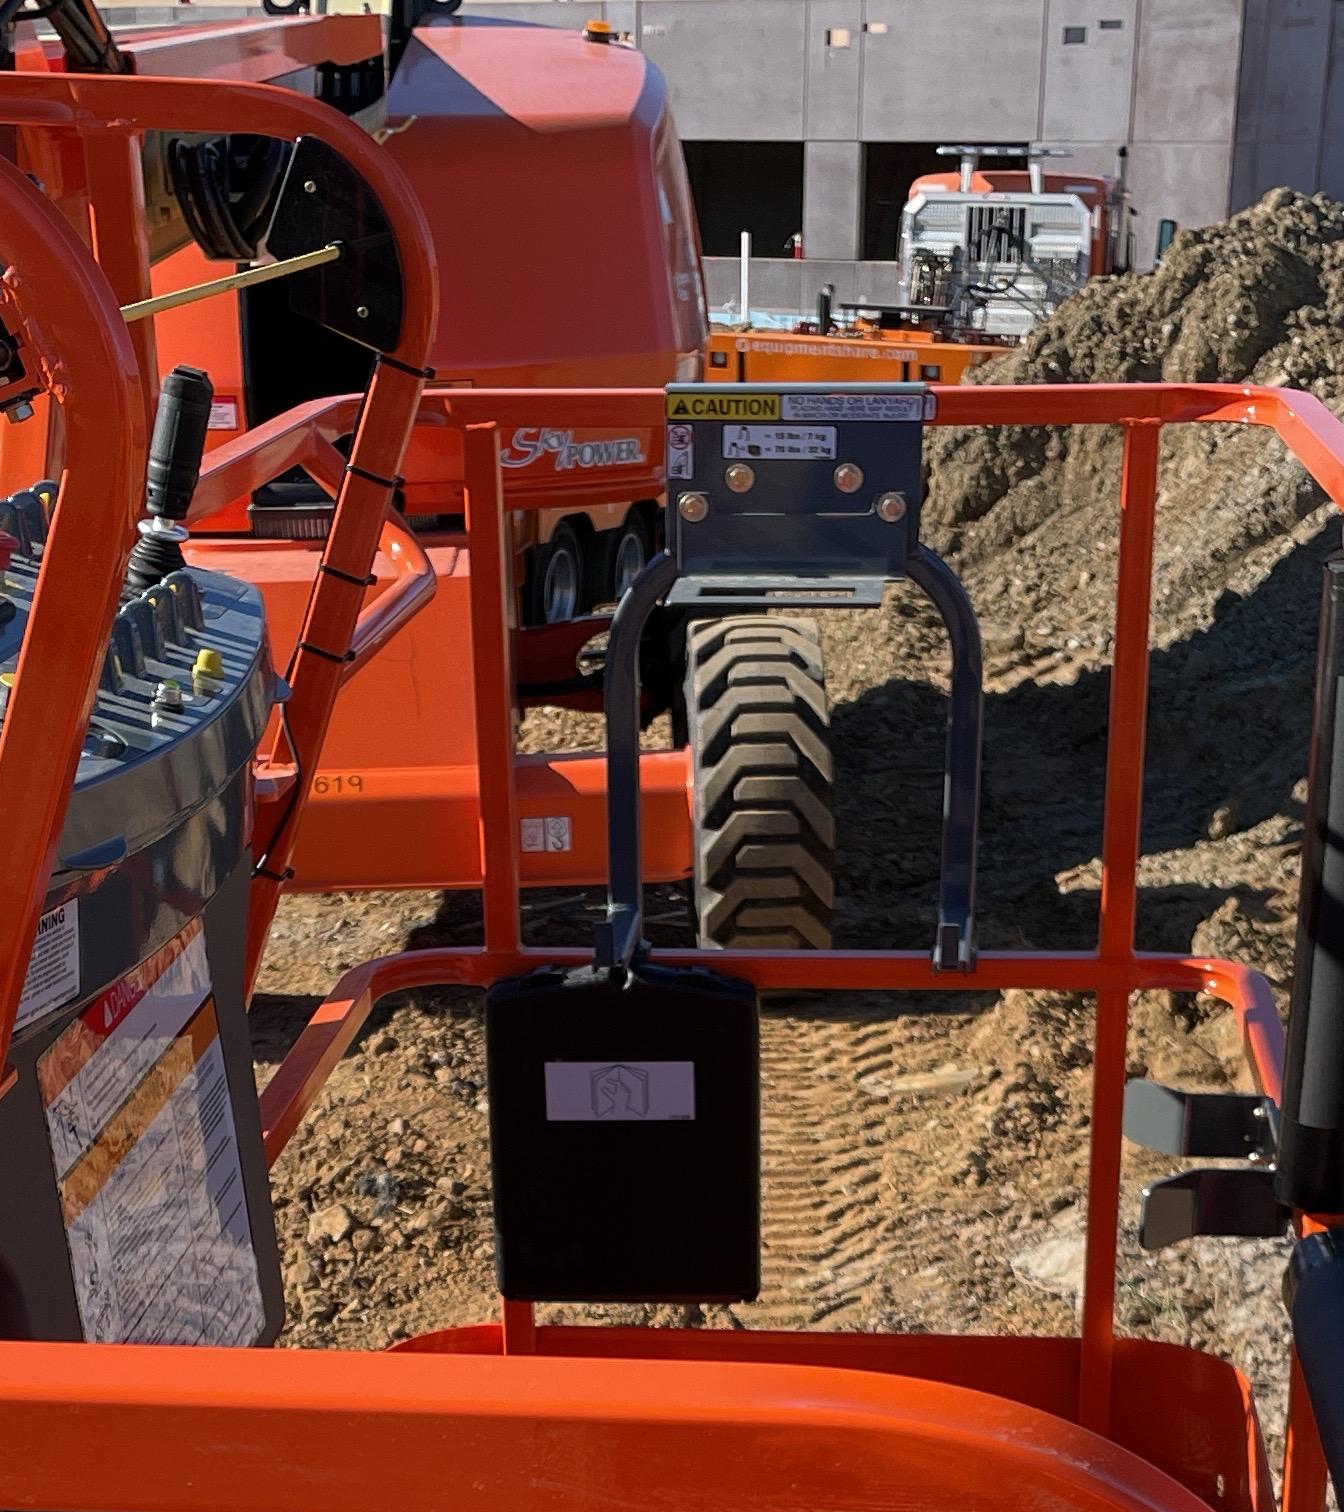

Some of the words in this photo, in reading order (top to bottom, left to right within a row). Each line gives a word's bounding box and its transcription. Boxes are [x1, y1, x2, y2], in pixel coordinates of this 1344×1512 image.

[691, 398, 776, 417] CAUTION
[313, 774, 364, 794] 619
[37, 907, 65, 936] NING
